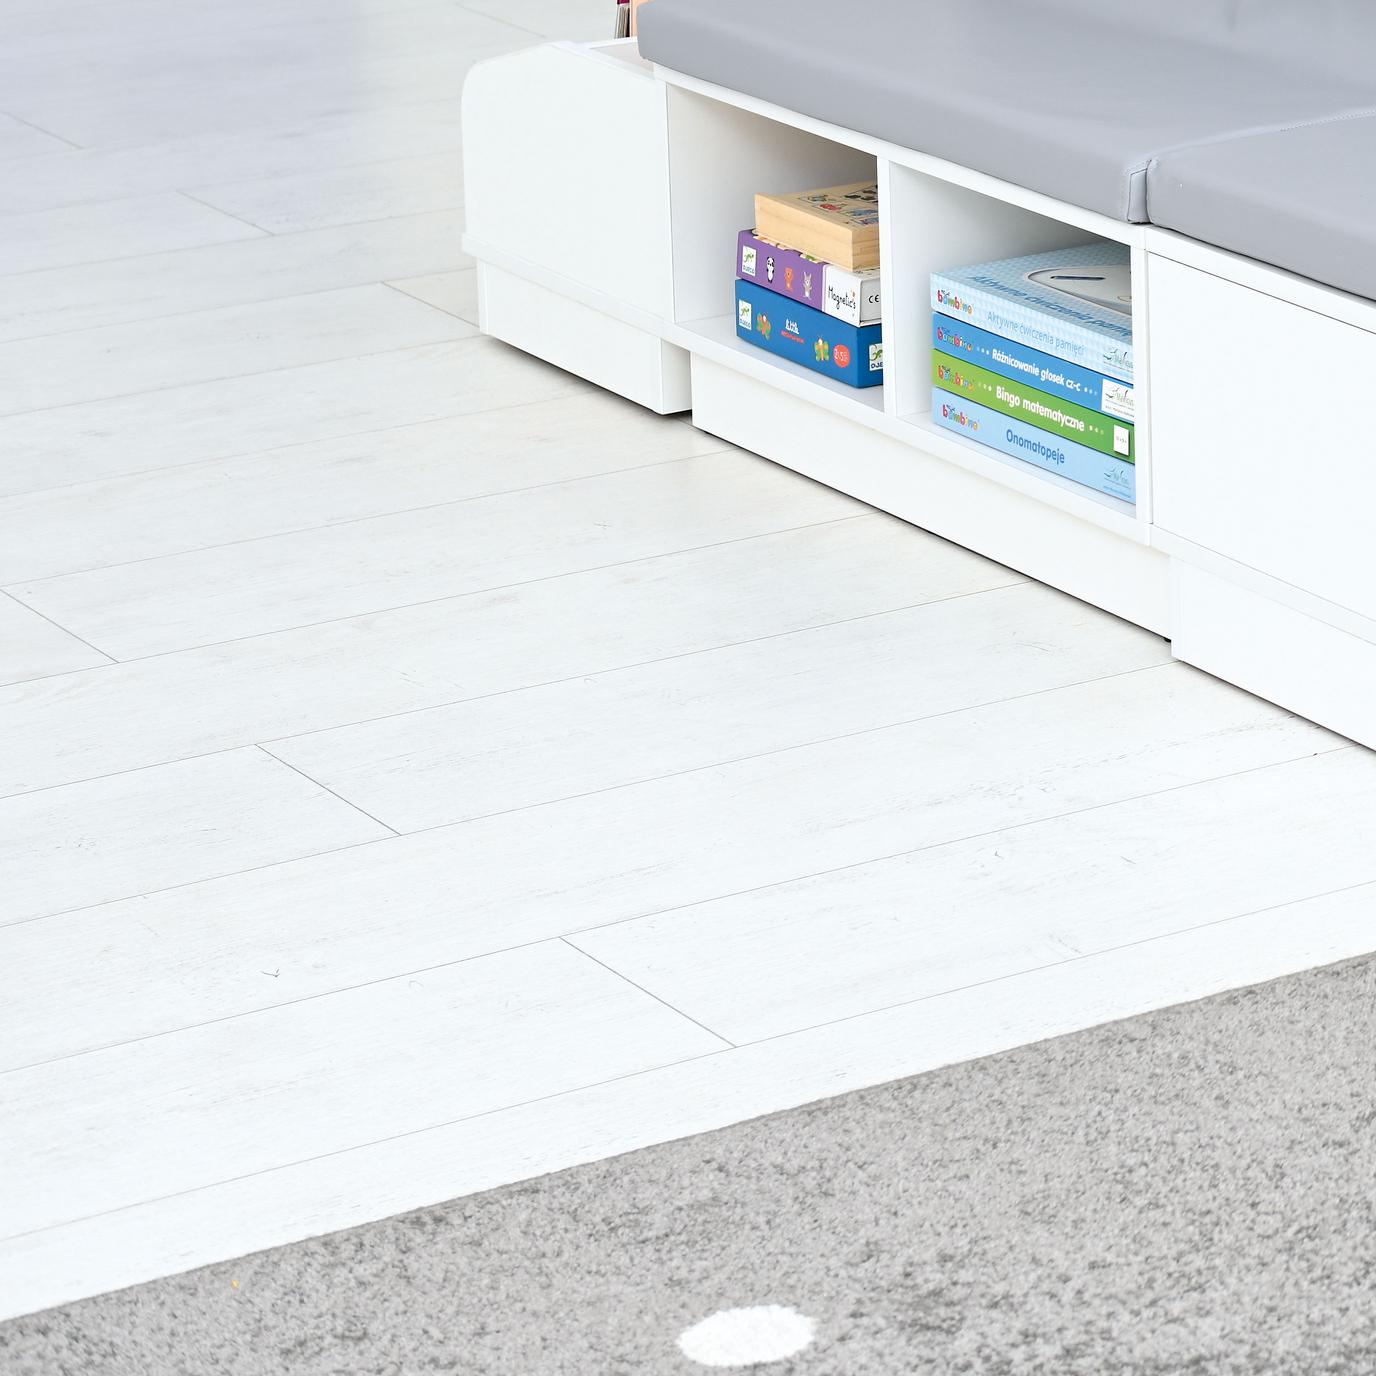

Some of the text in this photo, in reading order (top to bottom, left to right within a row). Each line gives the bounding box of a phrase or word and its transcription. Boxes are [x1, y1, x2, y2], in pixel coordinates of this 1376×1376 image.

[966, 276, 1027, 297] Aktywne
[937, 289, 974, 316] bambino
[937, 326, 973, 352] bambino
[987, 311, 1018, 331] Aktywne
[1019, 325, 1054, 345] ćwiczenia
[938, 365, 974, 392] bambino
[992, 349, 1081, 392] Różnicowanie głosek cz-c
[942, 404, 980, 431] bambino
[996, 386, 1020, 408] Bingo
[1022, 399, 1085, 432] matematyczne
[1006, 429, 1065, 466] Onomatopeje
